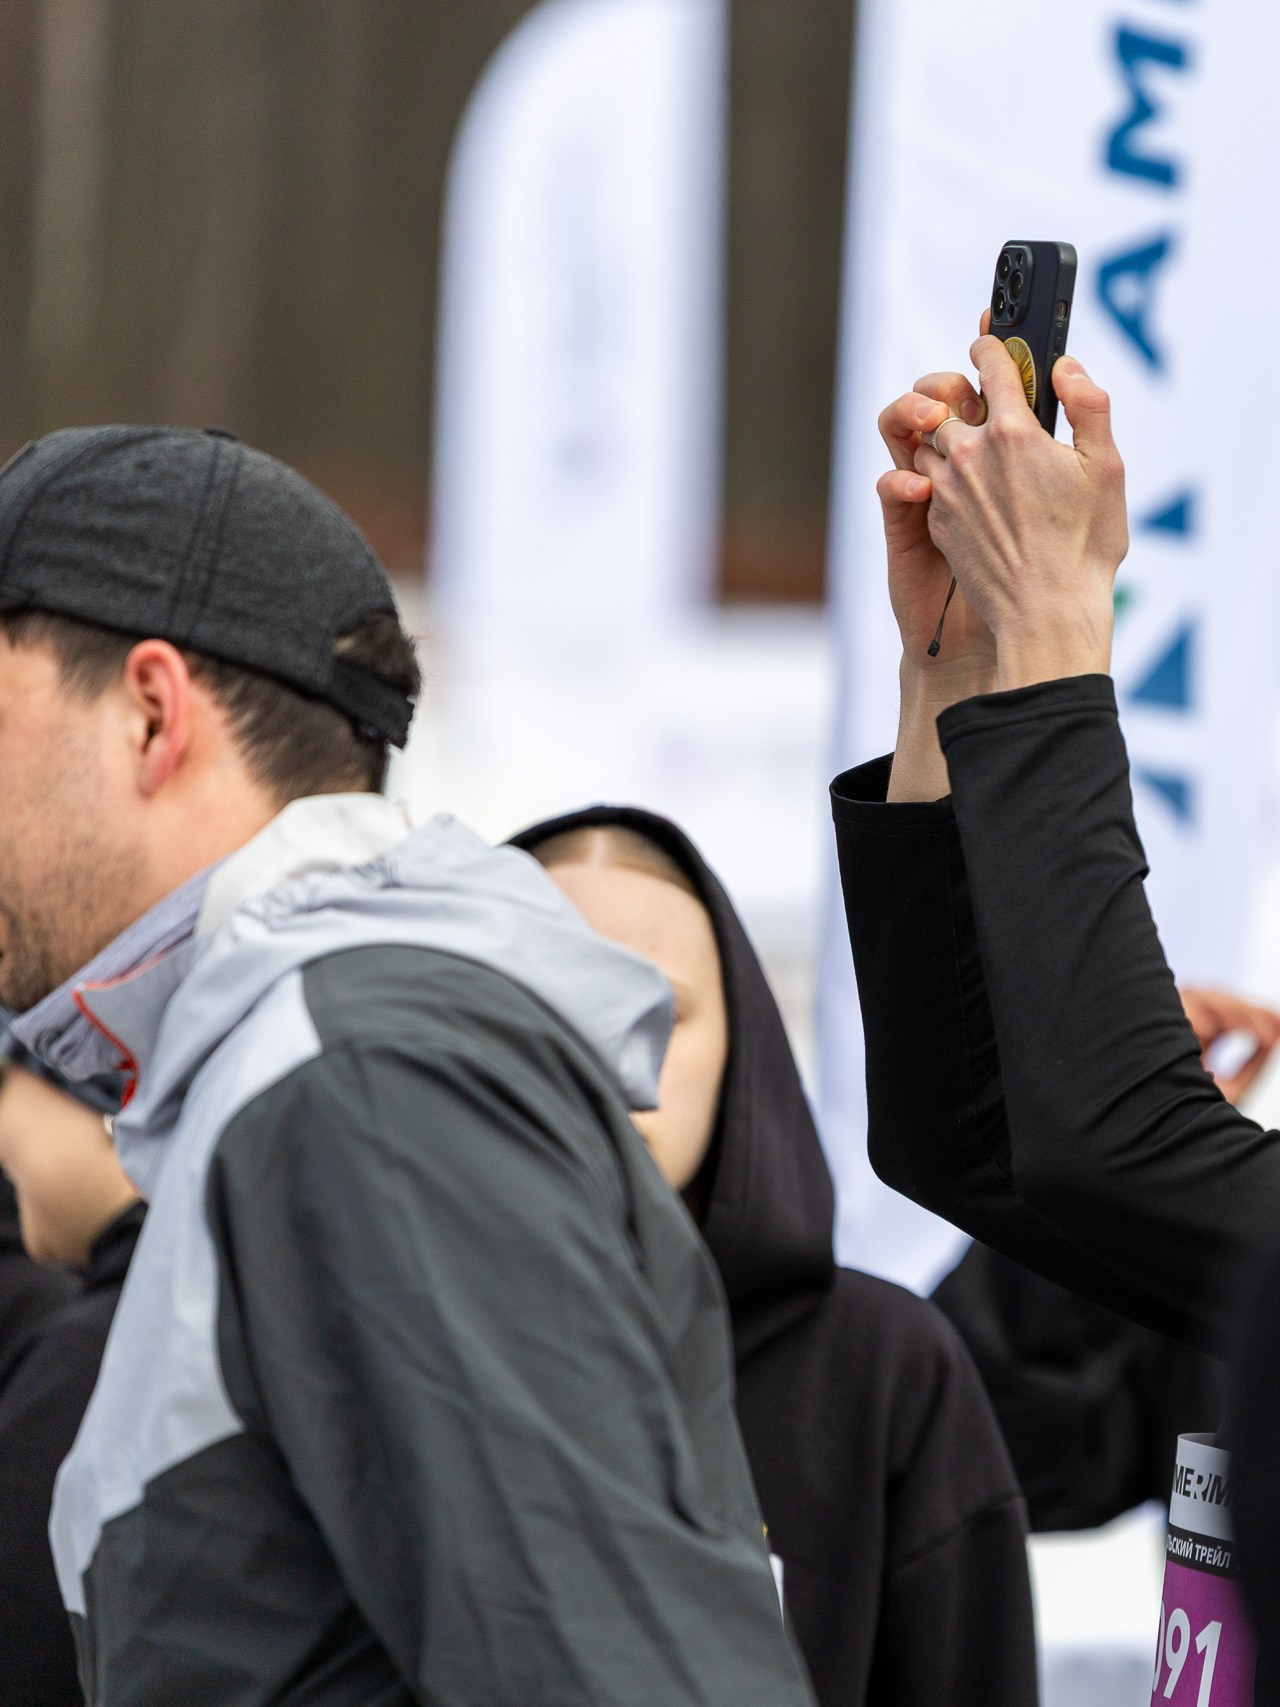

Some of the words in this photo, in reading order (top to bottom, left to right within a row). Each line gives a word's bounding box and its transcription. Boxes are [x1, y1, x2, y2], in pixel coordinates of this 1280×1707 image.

[1096, 0, 1197, 374] AM
[1167, 1534, 1193, 1559] ЬСКИЙ
[1194, 1543, 1232, 1569] ТРЕЙЛ
